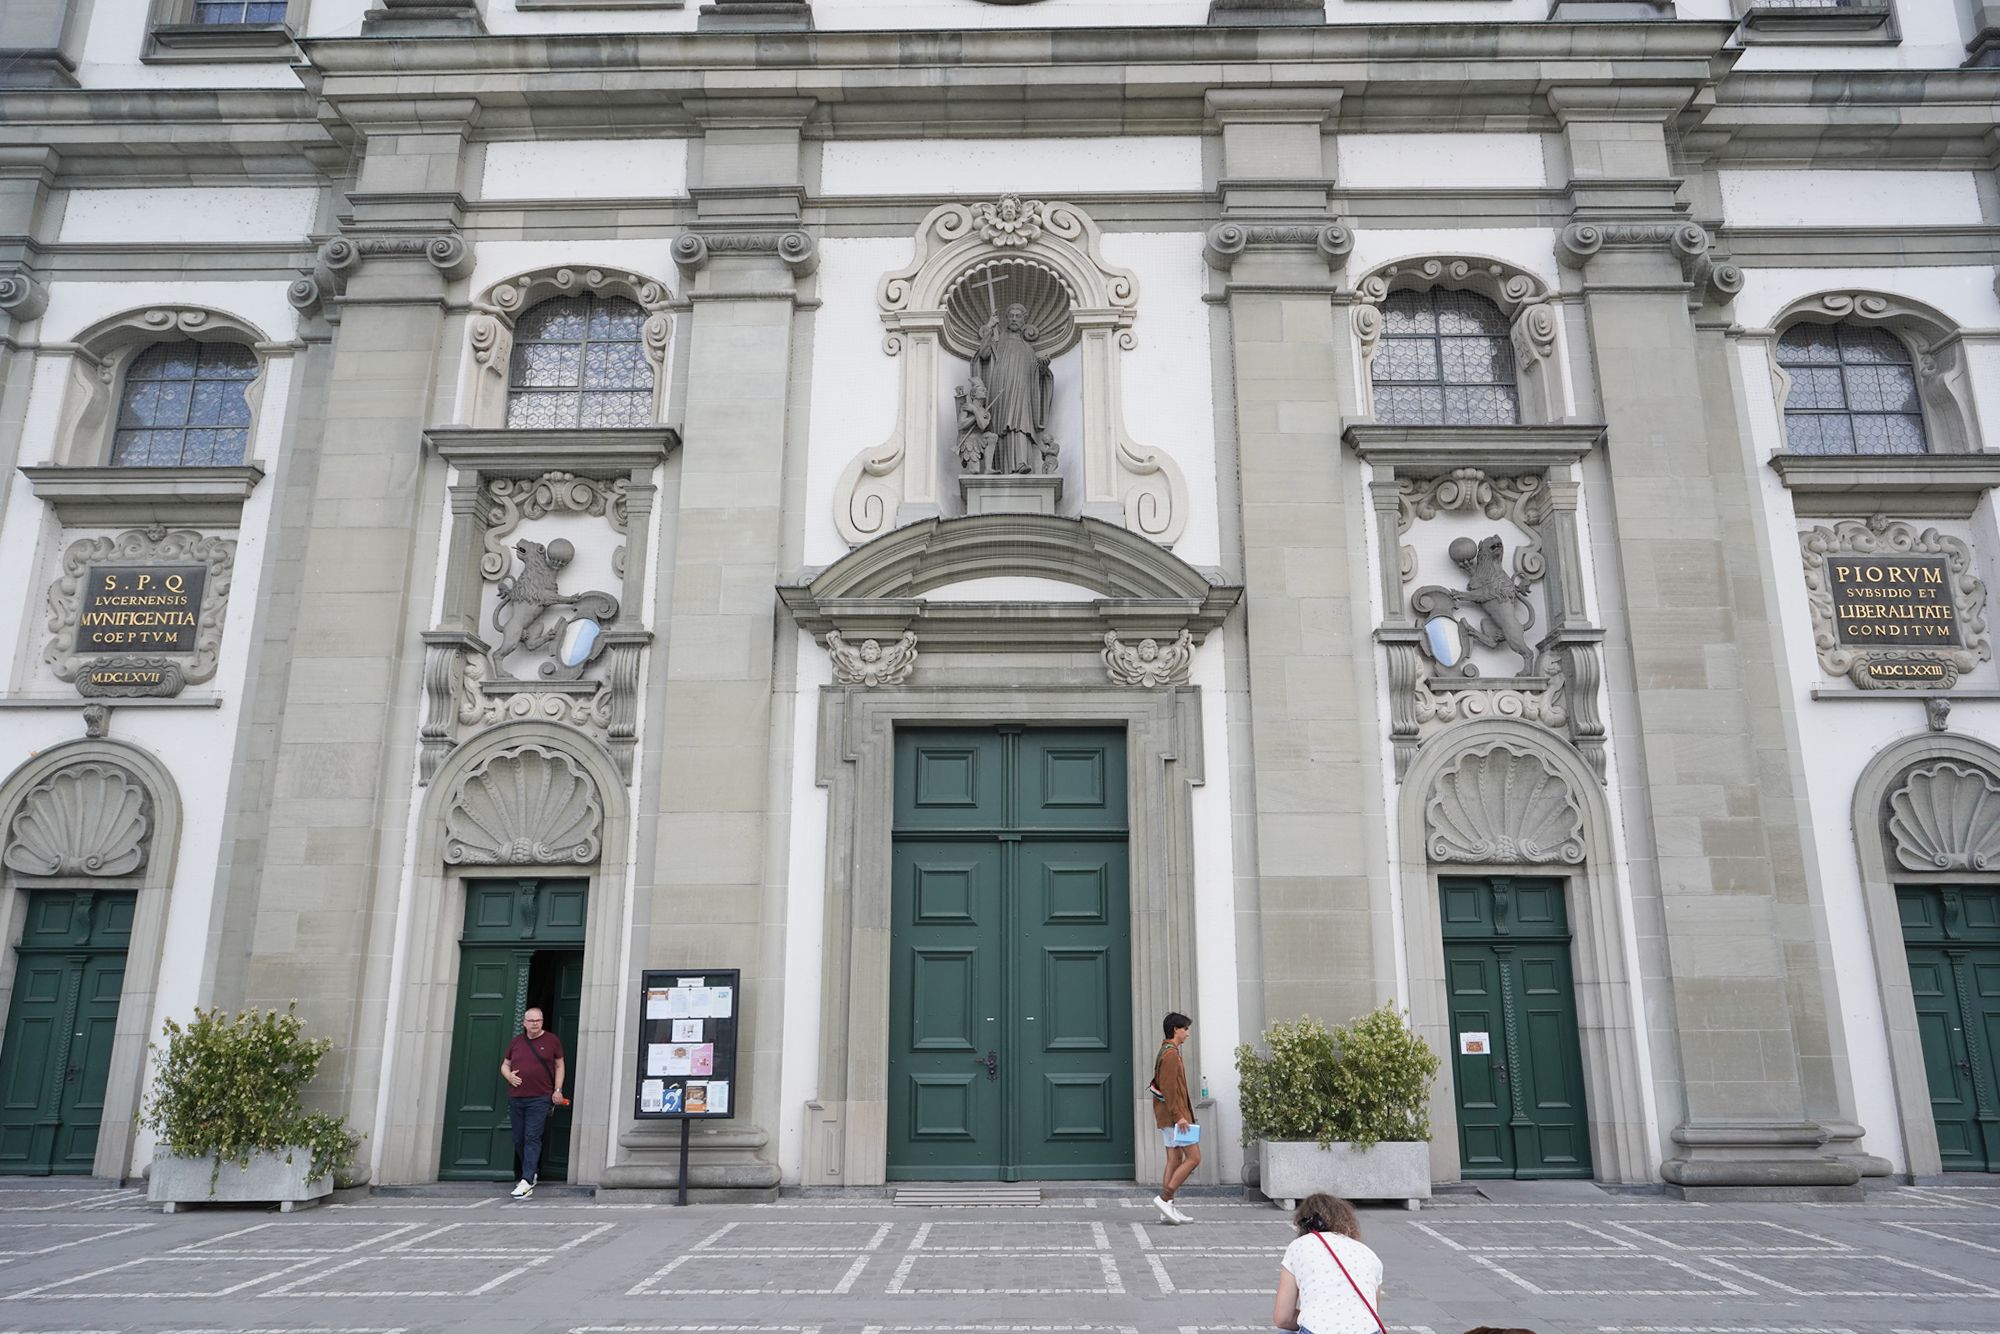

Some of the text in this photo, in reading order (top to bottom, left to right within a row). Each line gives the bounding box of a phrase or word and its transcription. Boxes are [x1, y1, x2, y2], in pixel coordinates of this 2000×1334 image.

[1836, 566, 1943, 584] PIORVM
[1847, 588, 1937, 599] SVBSIDIO ET
[95, 596, 188, 606] LVCERNENSIS
[1839, 605, 1953, 619] LIBERALITATE
[81, 612, 196, 626] MVNIFICENTIA
[1848, 625, 1950, 636] CONDITVM
[92, 632, 178, 643] COEPTVM
